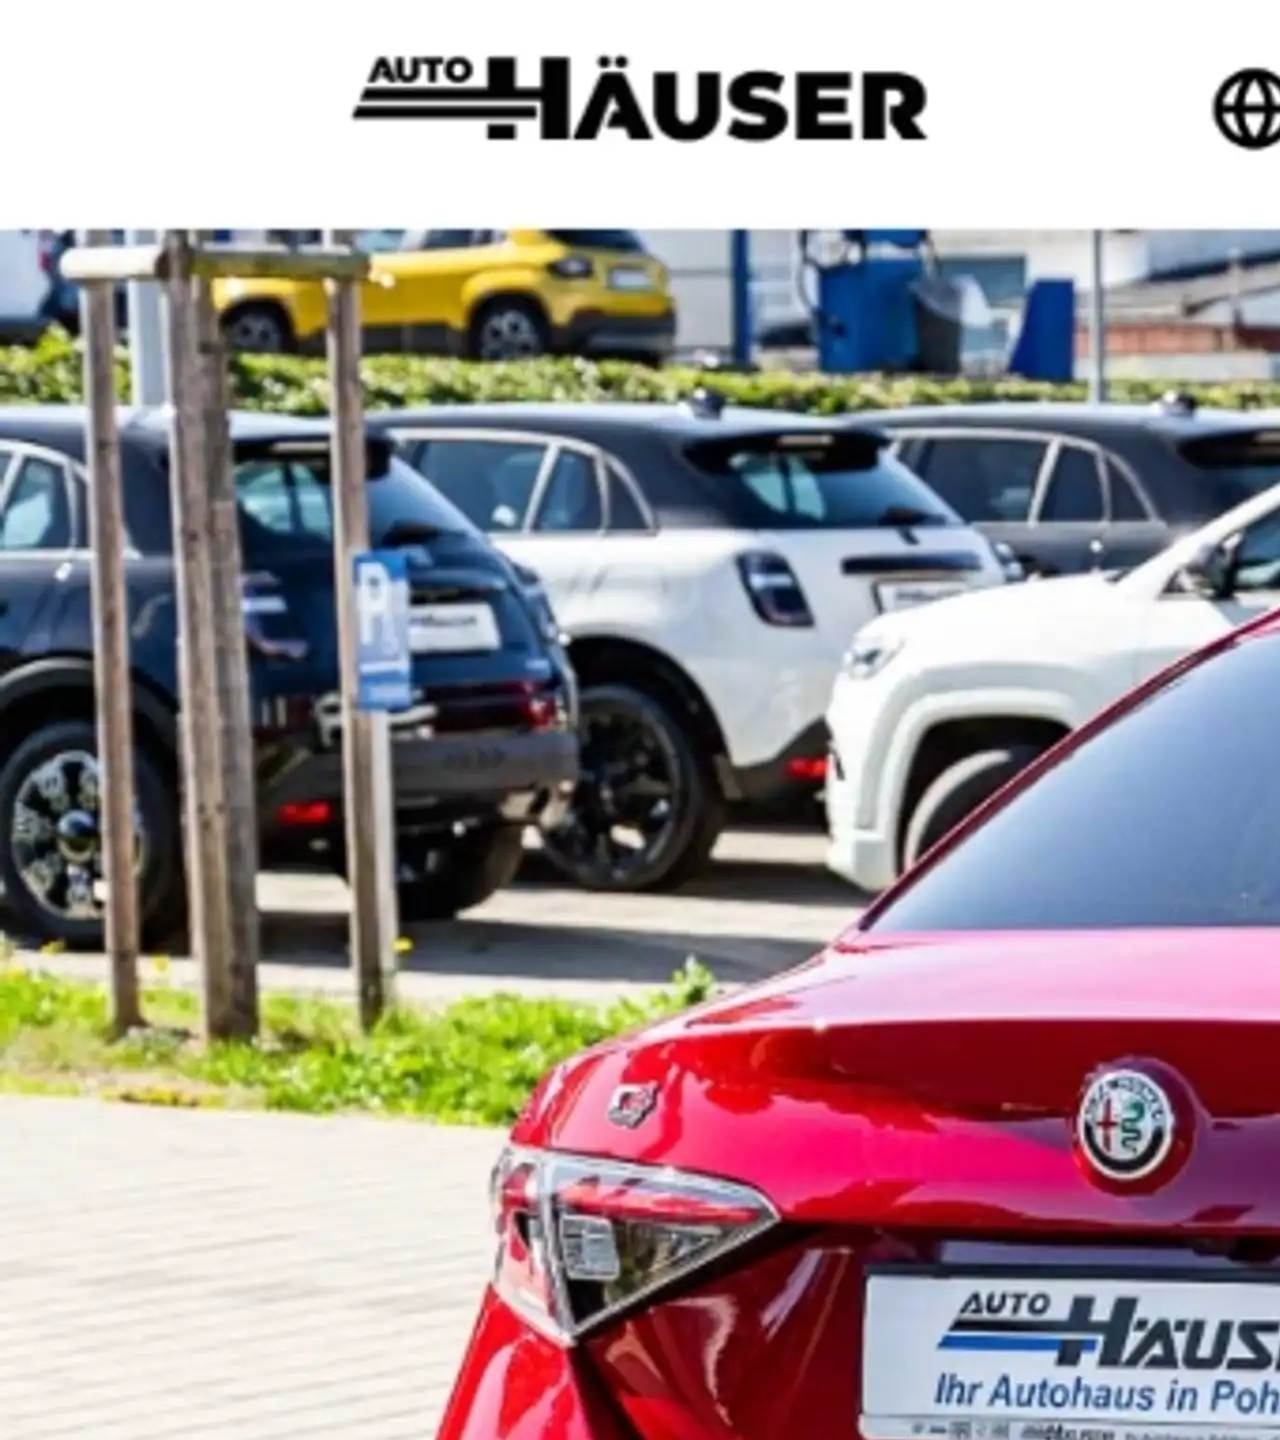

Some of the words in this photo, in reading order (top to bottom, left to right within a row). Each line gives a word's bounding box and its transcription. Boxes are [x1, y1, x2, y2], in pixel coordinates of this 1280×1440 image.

[959, 1291, 1052, 1317] AUTO
[934, 1372, 983, 1405] Ihr
[987, 1374, 1157, 1412] Autohaus
[1165, 1378, 1199, 1412] in
